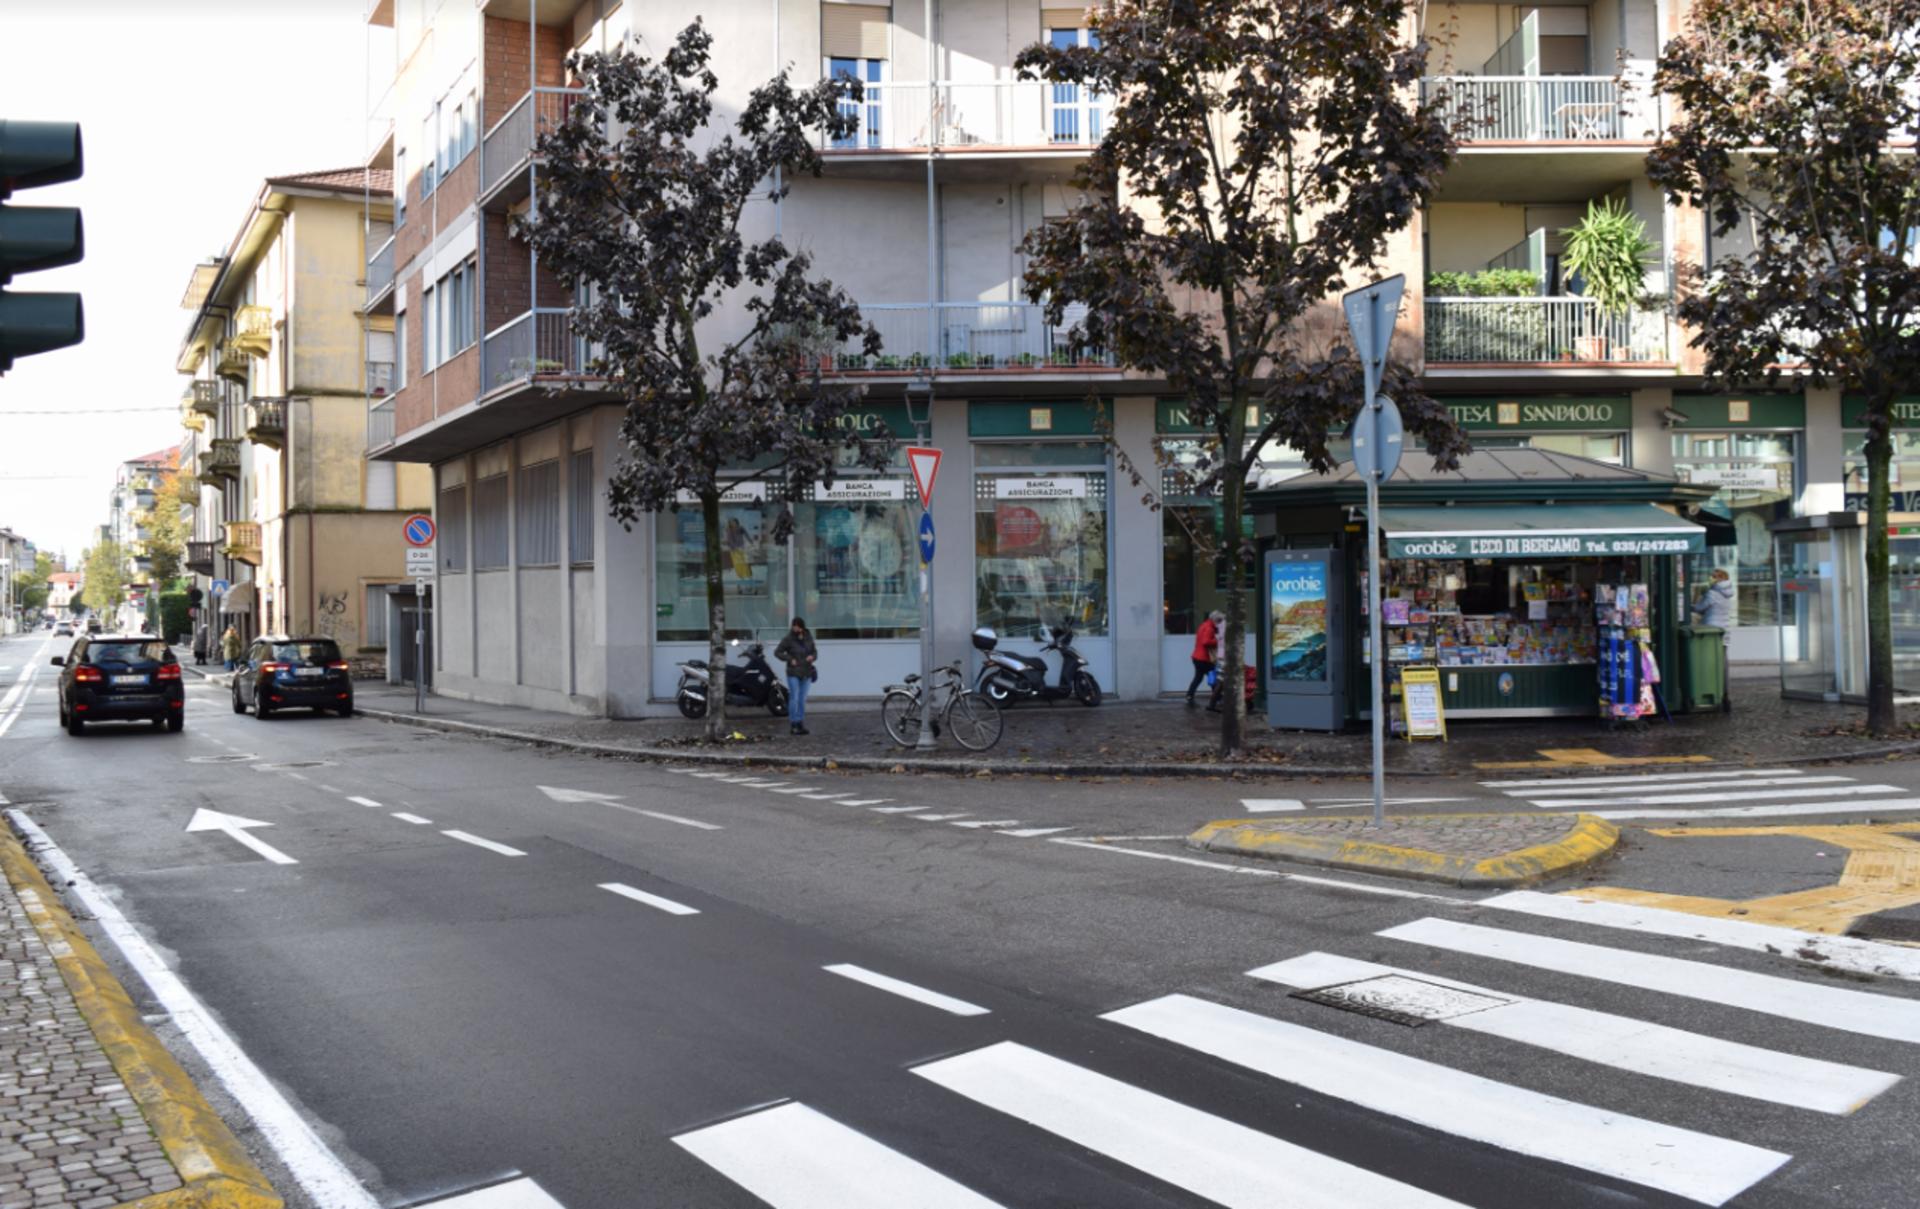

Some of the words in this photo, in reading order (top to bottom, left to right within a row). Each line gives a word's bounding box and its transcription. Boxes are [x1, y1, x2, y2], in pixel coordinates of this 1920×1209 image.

[1449, 406, 1492, 422] TESA
[1523, 405, 1612, 422] SANPAOLO
[1890, 403, 1920, 419] NTE
[1404, 540, 1457, 555] orobie
[1505, 539, 1519, 553] DI
[1521, 537, 1581, 553] BERGAMO
[1276, 575, 1321, 592] orobie
